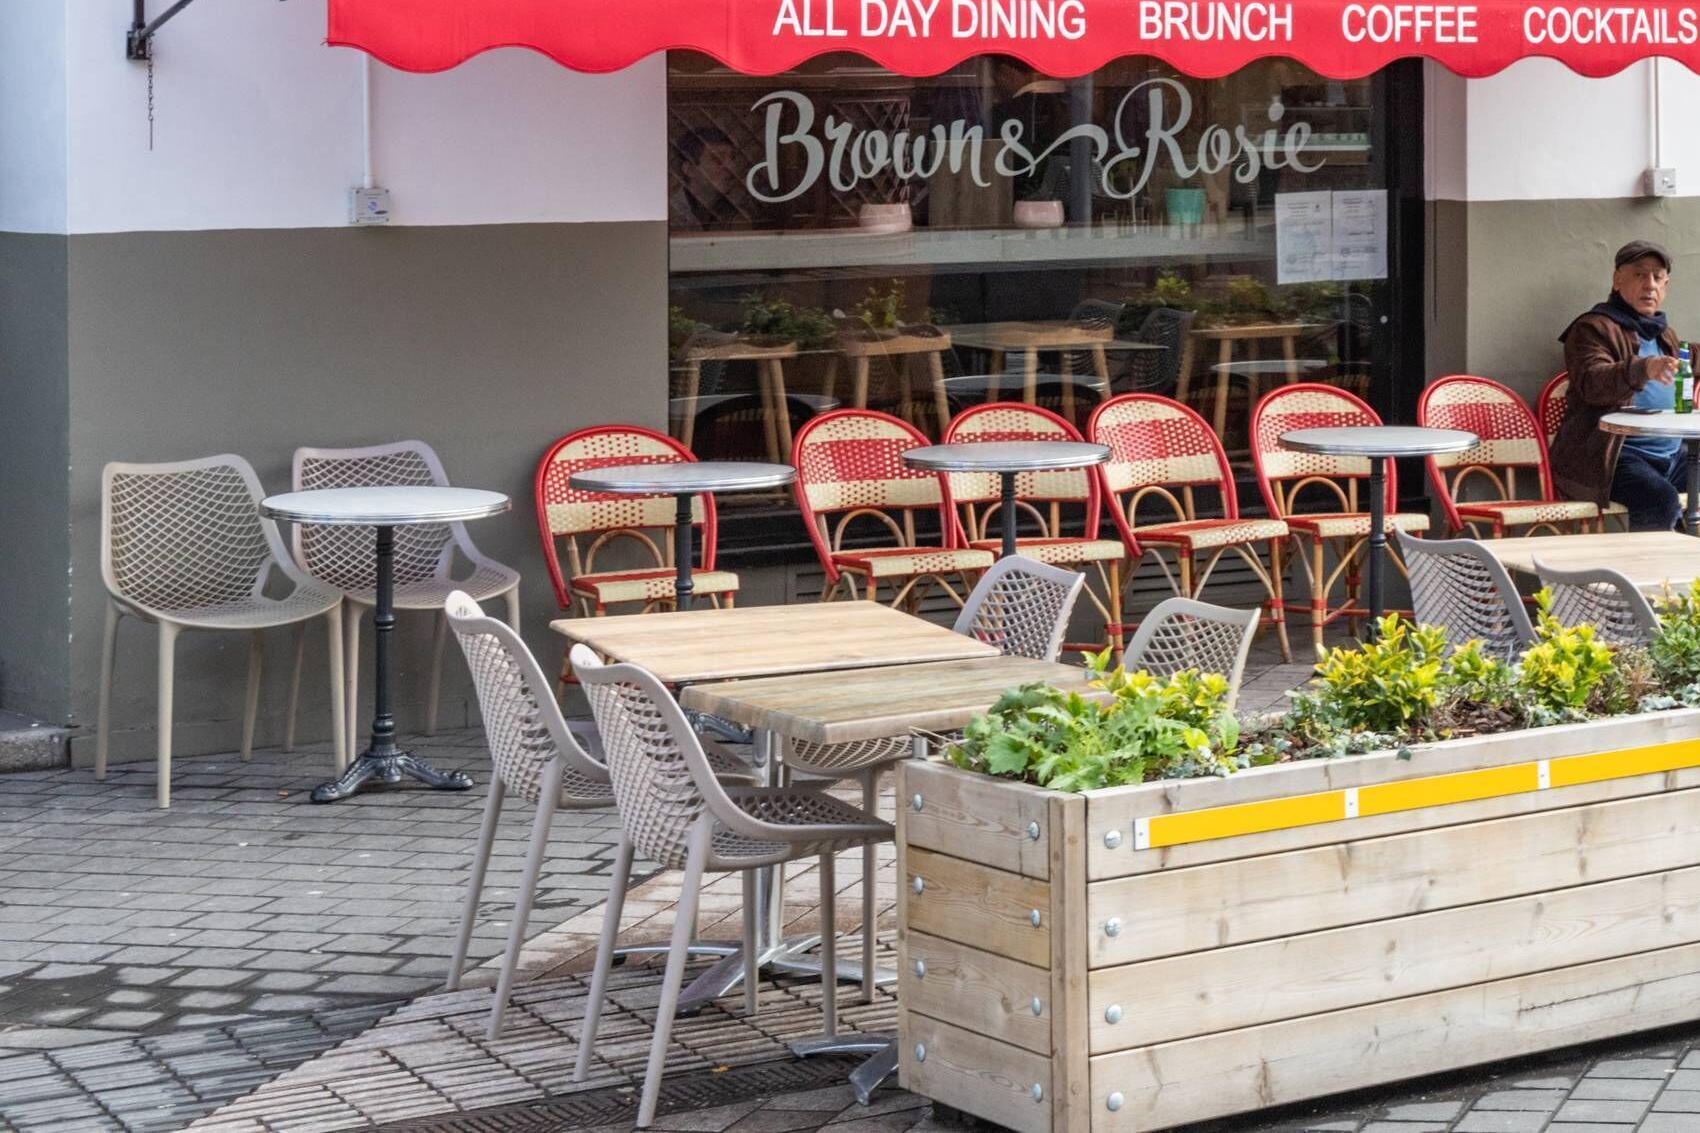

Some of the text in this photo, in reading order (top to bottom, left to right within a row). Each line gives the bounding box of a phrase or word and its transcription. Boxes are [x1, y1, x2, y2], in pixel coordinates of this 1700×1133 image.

[1138, 0, 1293, 41] BRUNCH
[1341, 3, 1479, 43] COFFEE
[1523, 6, 1699, 44] COCKTAILS
[745, 89, 992, 203] Brown
[1101, 76, 1328, 200] Rosie
